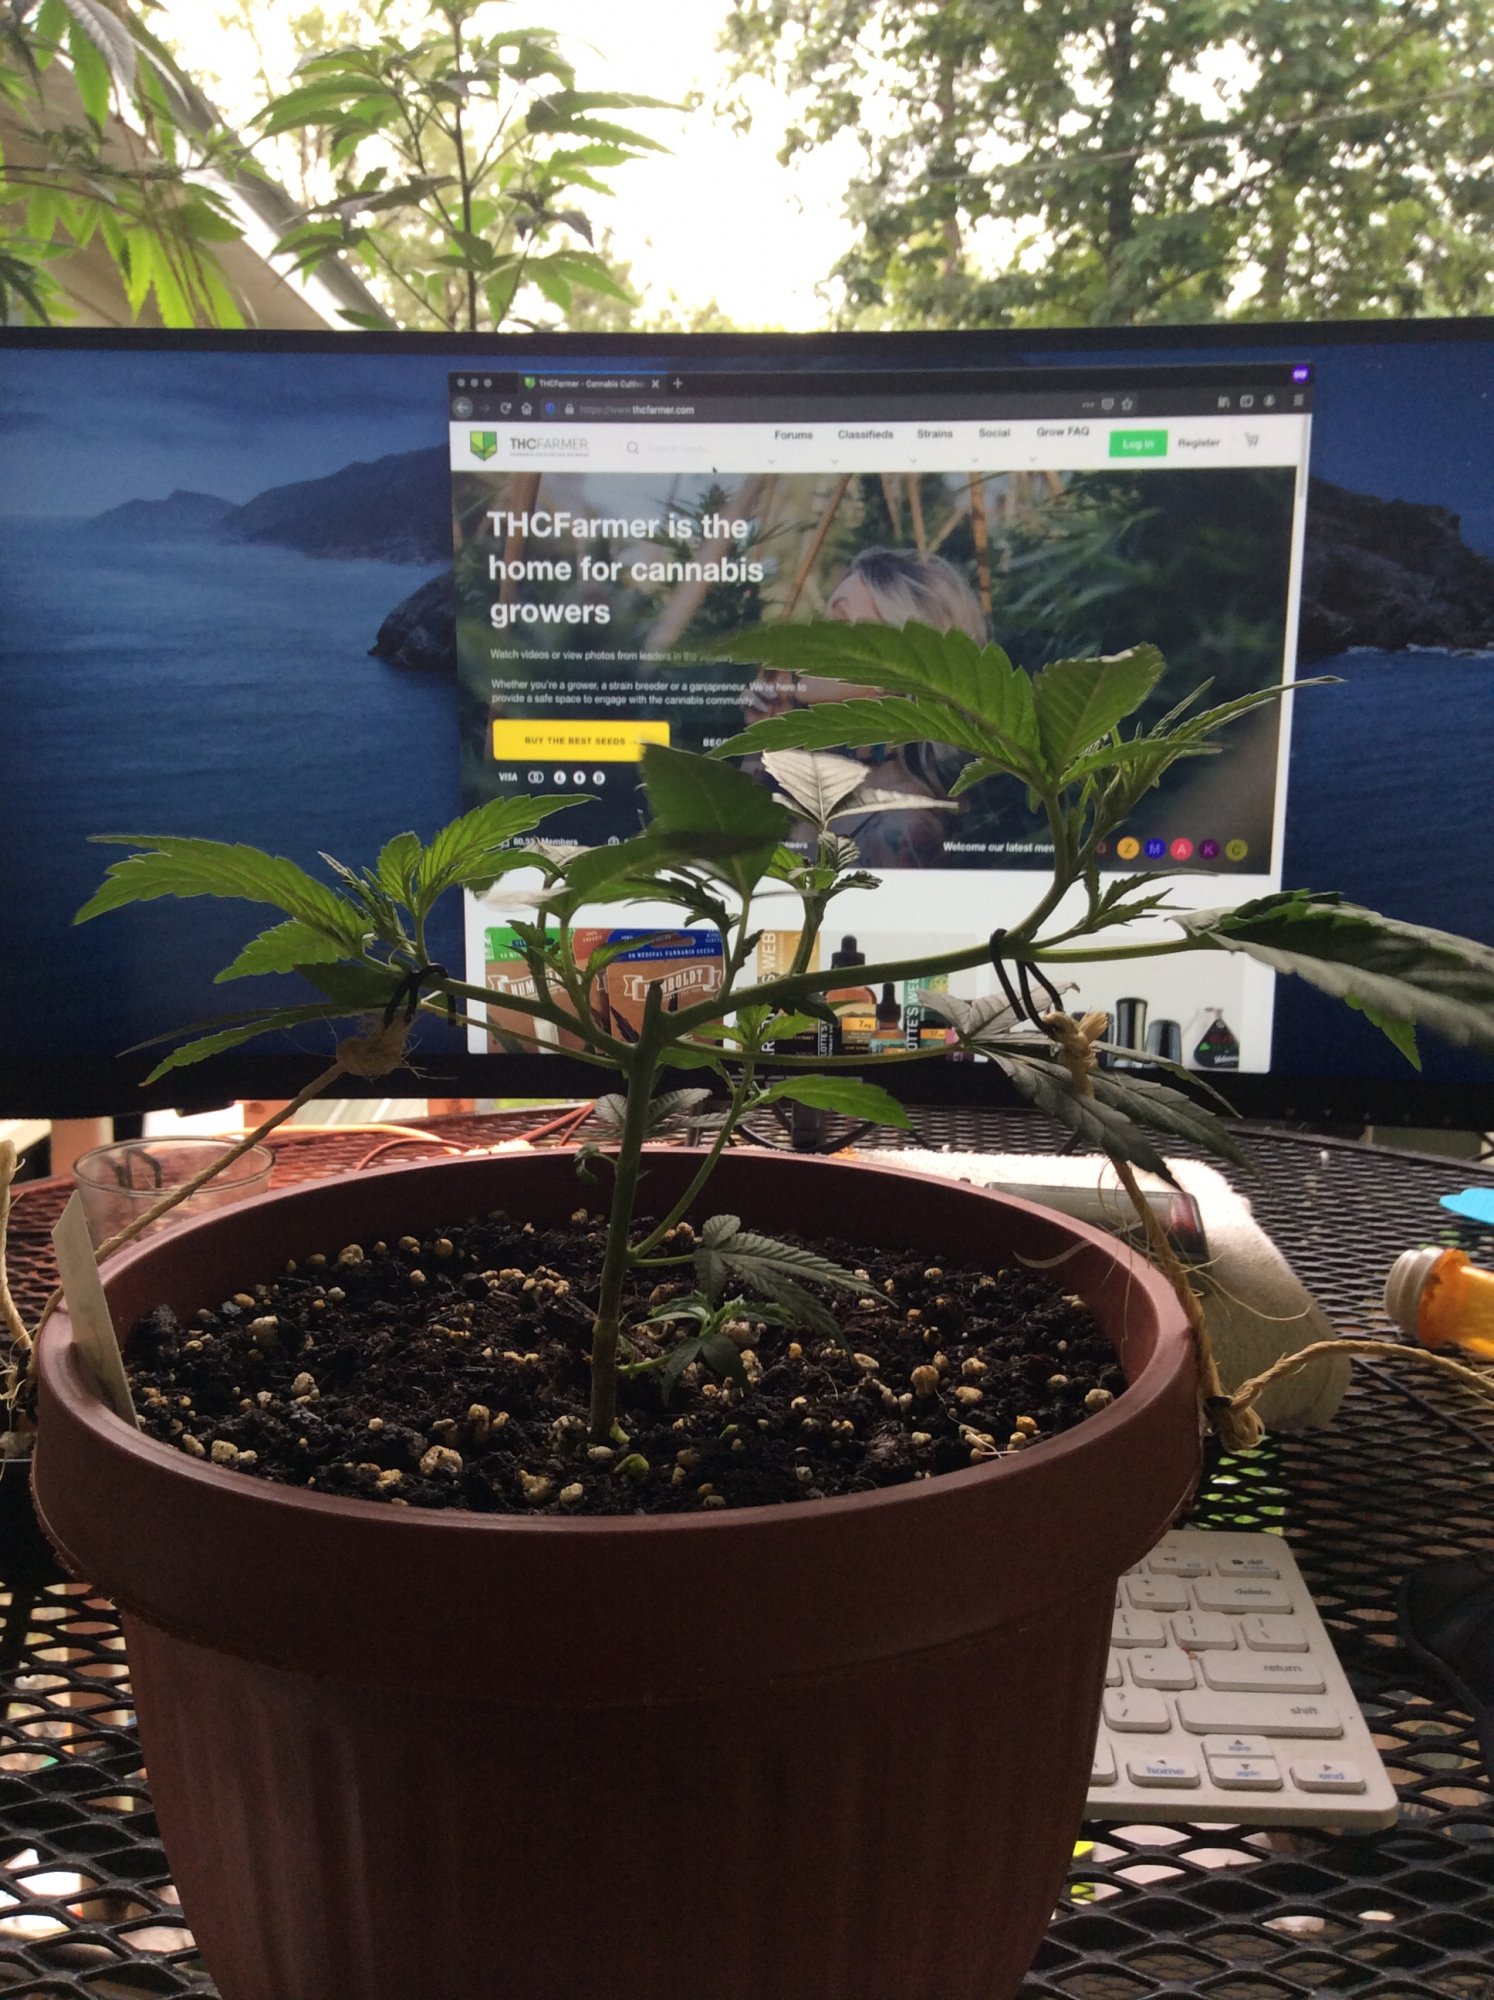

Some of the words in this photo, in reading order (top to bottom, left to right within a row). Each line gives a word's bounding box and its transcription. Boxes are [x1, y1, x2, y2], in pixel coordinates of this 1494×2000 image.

[539, 379, 580, 388] THCFarmer
[586, 379, 618, 388] Cannabis
[774, 430, 813, 441] Forums
[838, 428, 894, 440] Classifieds
[917, 428, 953, 440] Strains
[978, 427, 1011, 438] Social
[1036, 426, 1061, 438] Grow
[1062, 426, 1090, 438] FAQ
[510, 437, 588, 450] THCFARMER
[1123, 439, 1142, 452] Log
[1145, 438, 1155, 450] in
[1178, 438, 1221, 450] Register
[487, 510, 660, 539] THCFarmer
[670, 512, 692, 539] is
[701, 513, 749, 539] the
[488, 556, 572, 581] home
[581, 556, 623, 581] for
[630, 556, 764, 582] cannabis
[490, 602, 611, 629] growers
[490, 649, 519, 660] Watch
[520, 650, 550, 660] videos
[552, 652, 560, 660] or
[562, 650, 583, 660] view
[584, 650, 616, 662] photos
[617, 651, 638, 660] from
[639, 651, 672, 661] leaders
[491, 680, 528, 690] Whether
[530, 680, 558, 692] you're
[559, 682, 566, 690] a
[567, 682, 599, 692] grower,
[601, 683, 607, 691] a
[608, 680, 633, 691] strain
[634, 681, 668, 691] breeder
[670, 683, 680, 691] or
[776, 682, 795, 692] here
[796, 683, 808, 692] to
[492, 694, 525, 705] provide
[527, 696, 533, 704] a
[534, 694, 554, 704] safe
[555, 696, 582, 706] space
[584, 694, 592, 704] to
[594, 696, 627, 706] engage
[628, 694, 647, 704] with
[648, 695, 664, 705] the
[664, 696, 703, 706] cannabis
[525, 736, 544, 744] BUY
[548, 737, 565, 745] THE
[568, 737, 592, 745] BEST
[596, 738, 626, 746] SEEDS
[498, 772, 518, 782] VISA
[943, 841, 987, 852] Welcome
[988, 843, 1005, 852] our
[1006, 842, 1033, 852] latest
[762, 932, 776, 970] WEB
[1264, 1664, 1302, 1672] return
[1290, 1706, 1318, 1716] shift
[1146, 1766, 1185, 1776] home
[1319, 1772, 1345, 1781] end
